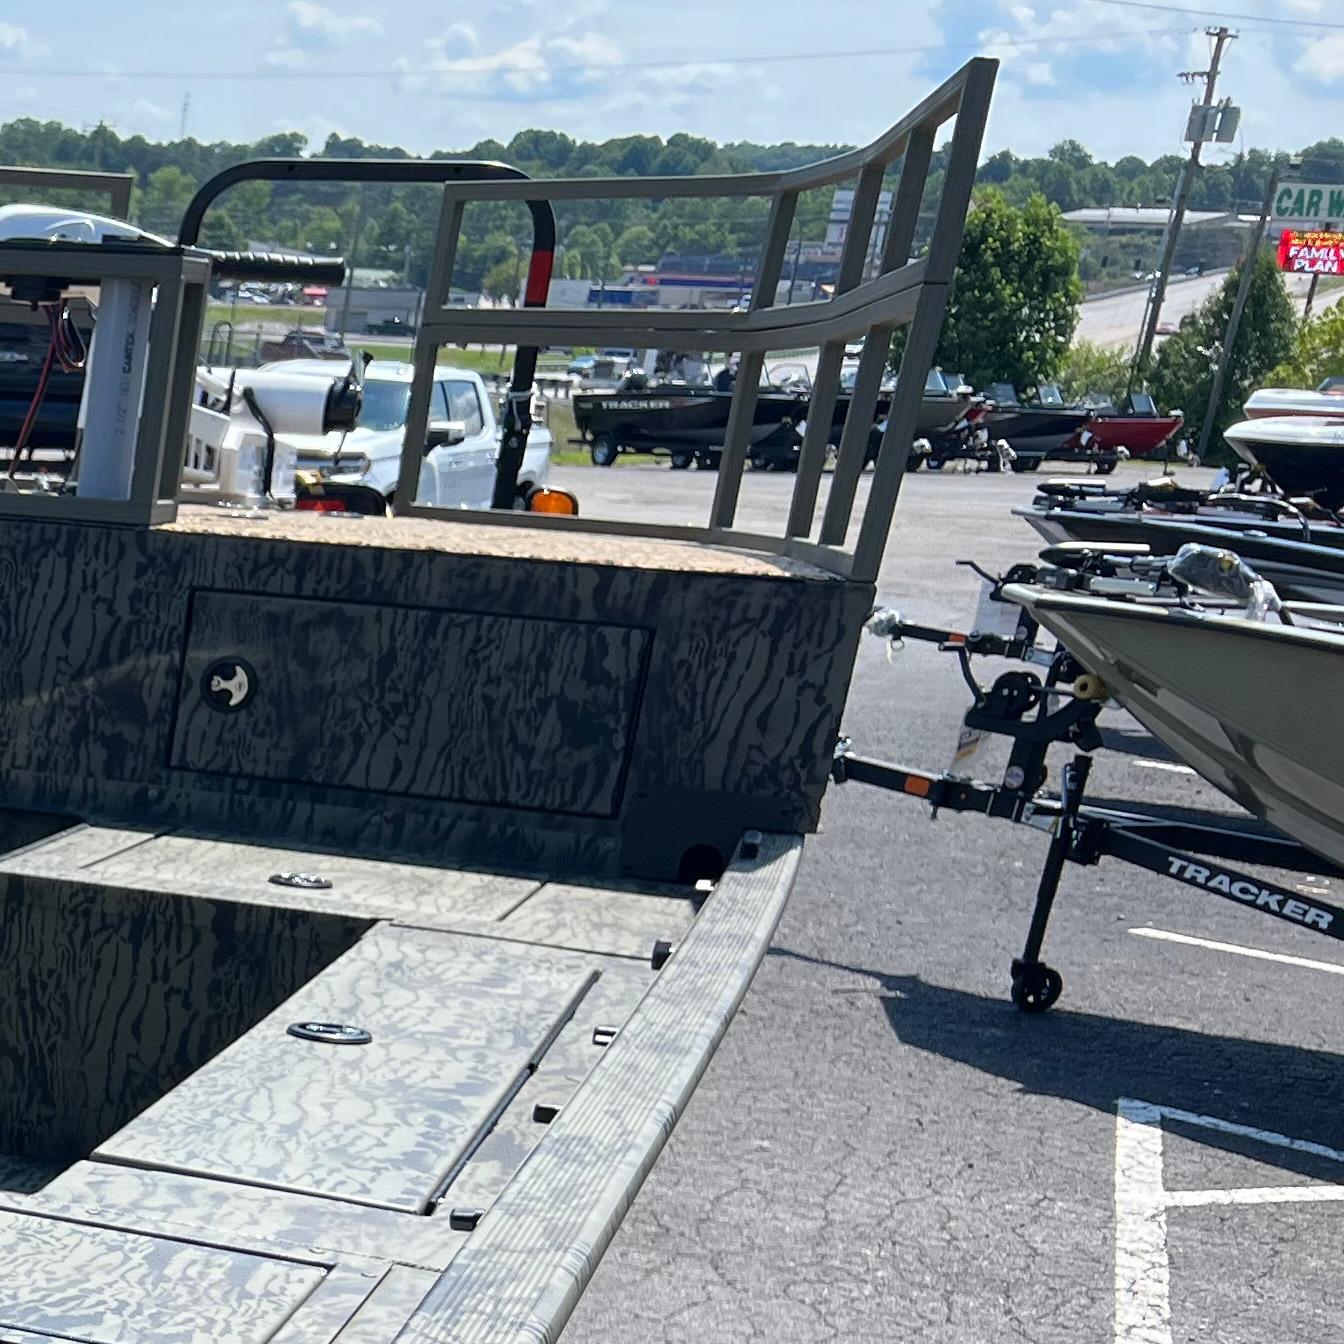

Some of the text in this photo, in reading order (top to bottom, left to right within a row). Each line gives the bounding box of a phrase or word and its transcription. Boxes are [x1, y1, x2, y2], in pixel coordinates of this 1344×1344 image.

[1276, 187, 1324, 217] CAR
[1293, 261, 1339, 273] PLAN
[1168, 855, 1334, 931] TRACKER
